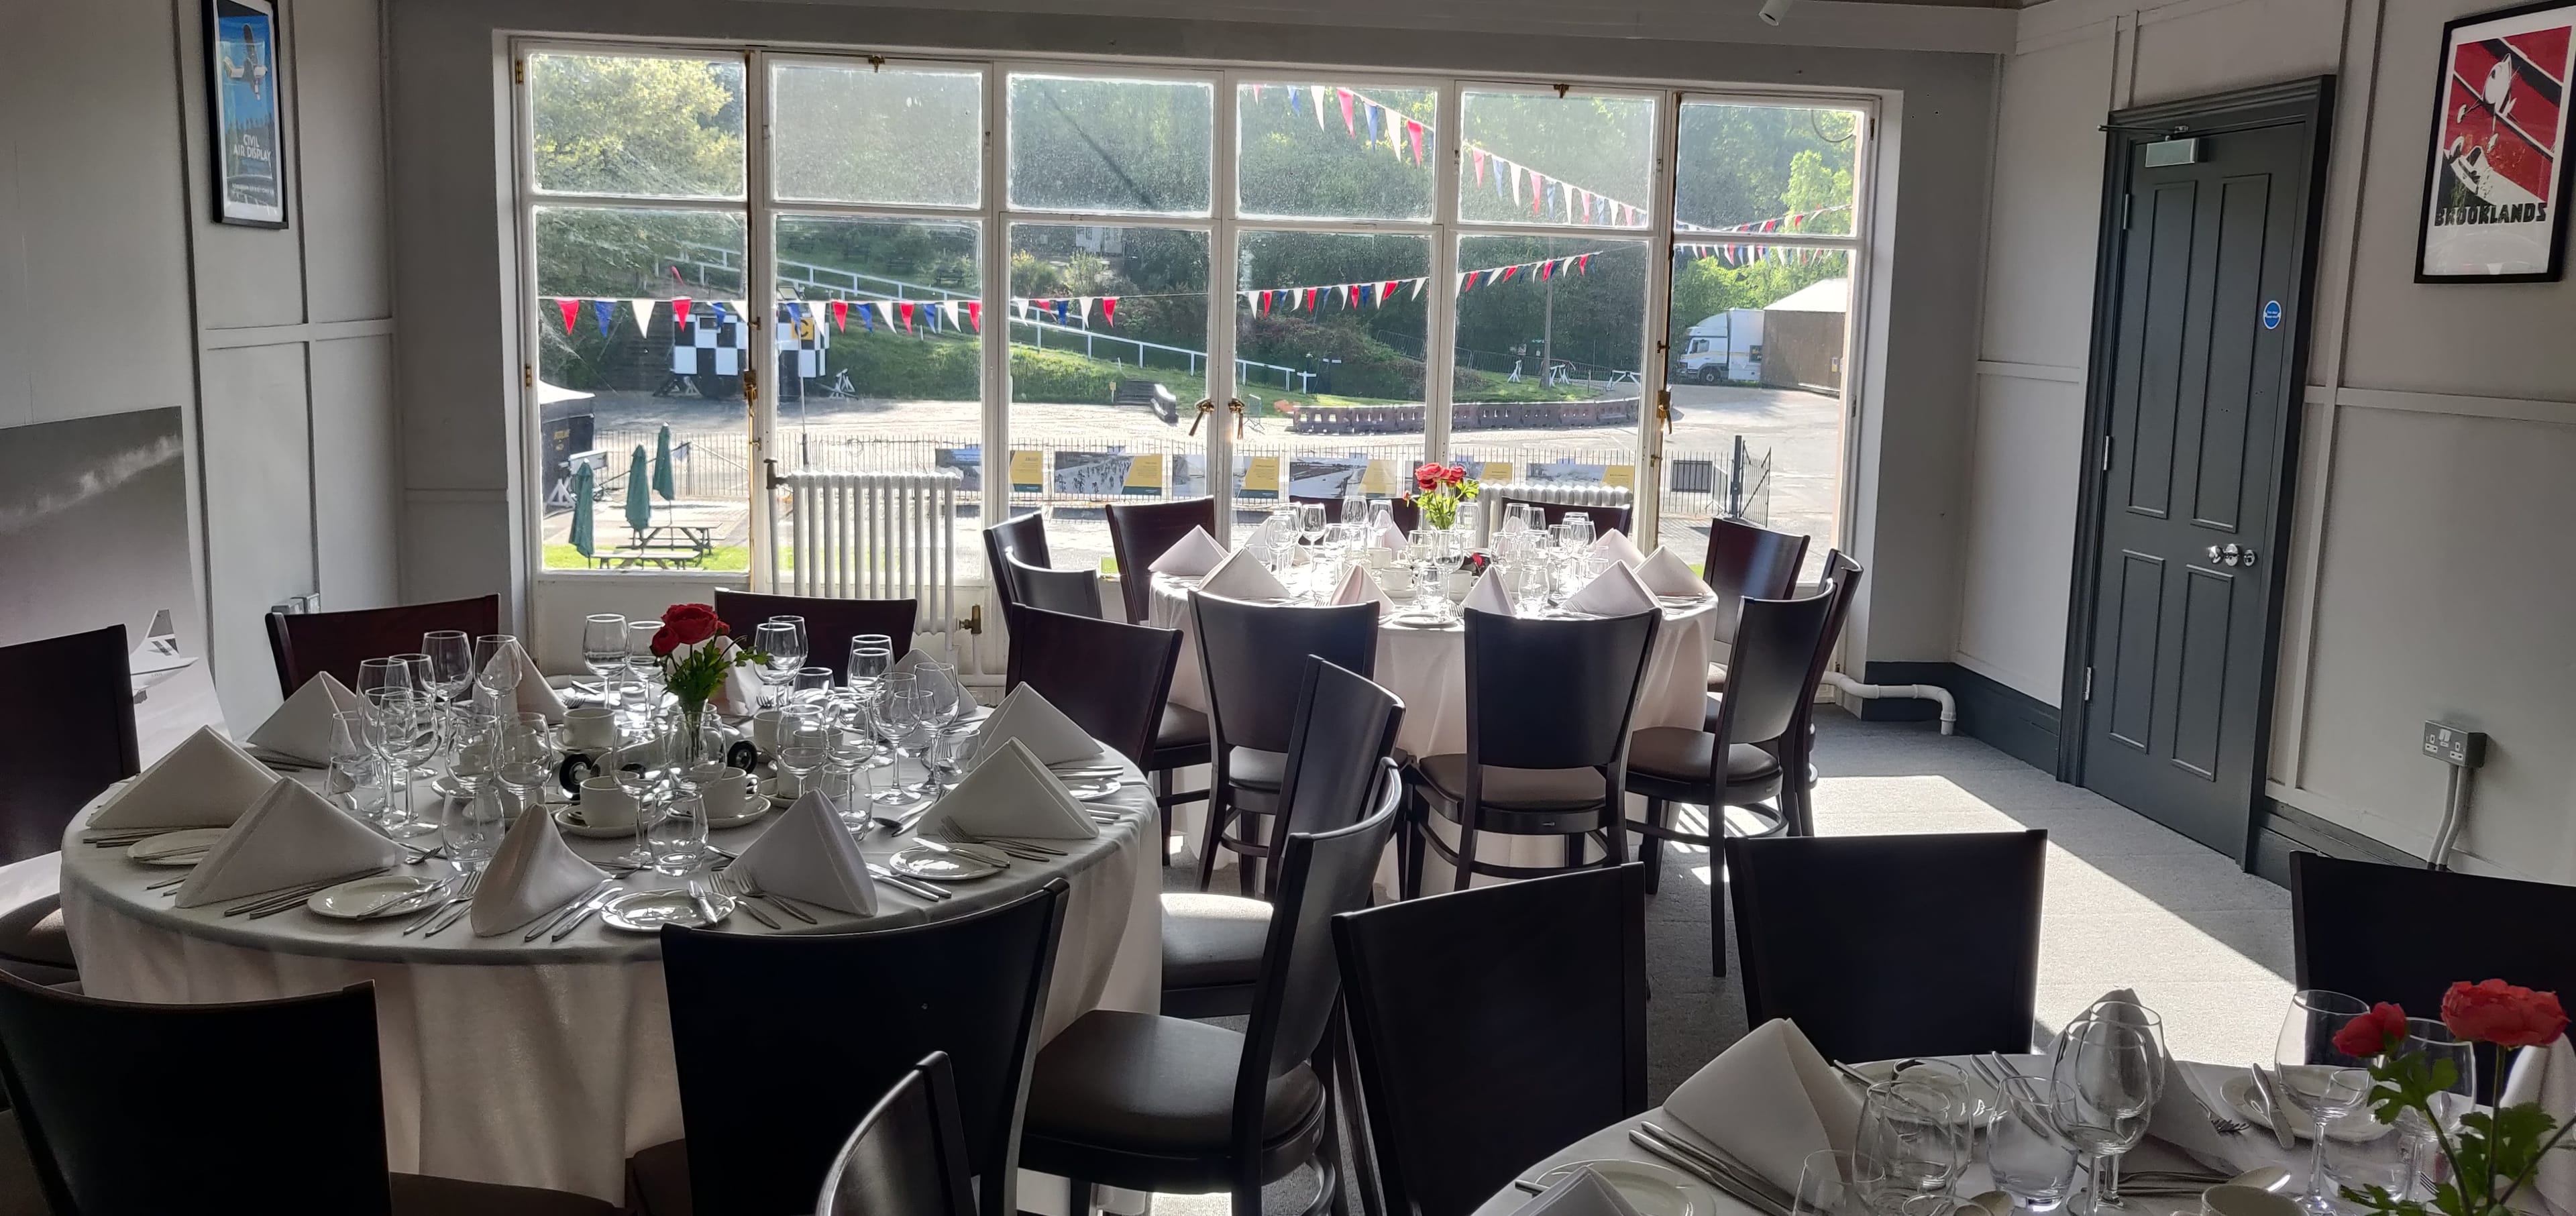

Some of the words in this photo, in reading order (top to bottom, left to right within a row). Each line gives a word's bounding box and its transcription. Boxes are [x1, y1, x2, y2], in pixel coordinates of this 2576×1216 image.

[244, 134, 260, 148] CIVIL
[233, 144, 246, 156] AIR
[247, 146, 271, 161] DISPLAY
[2434, 203, 2548, 227] BROOKLANDS
